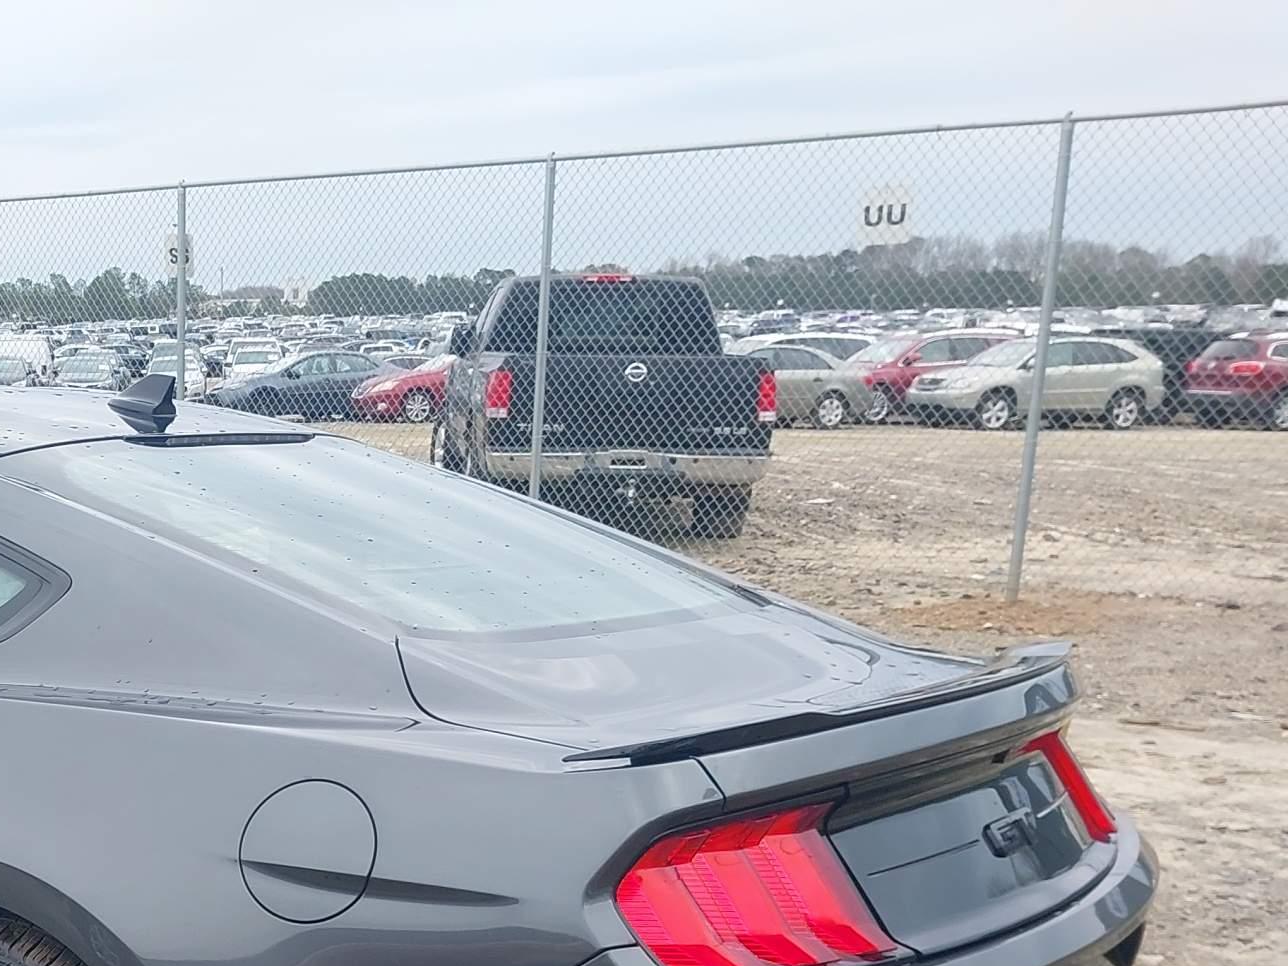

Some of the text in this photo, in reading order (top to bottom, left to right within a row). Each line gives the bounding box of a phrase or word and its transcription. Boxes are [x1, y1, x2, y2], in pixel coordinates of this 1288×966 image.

[864, 203, 907, 227] UU
[516, 422, 565, 433] TIAN
[981, 805, 1038, 858] GT
